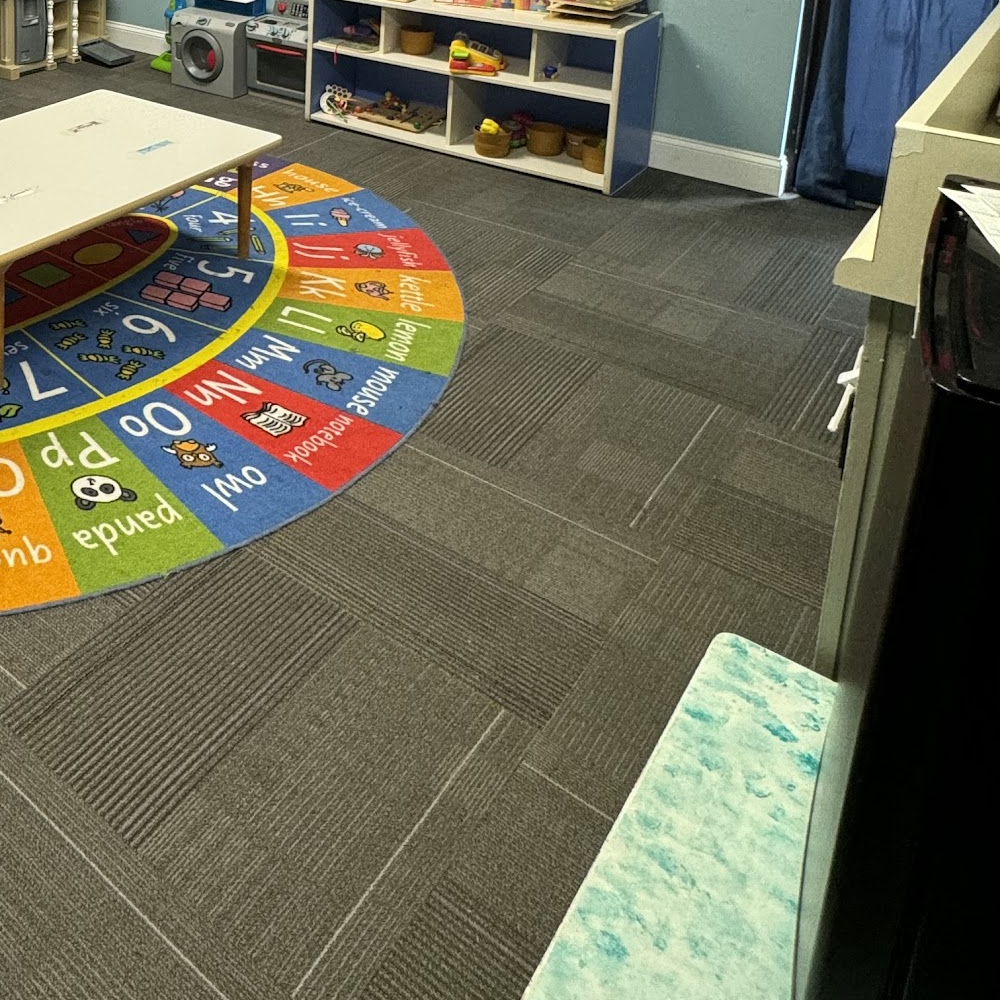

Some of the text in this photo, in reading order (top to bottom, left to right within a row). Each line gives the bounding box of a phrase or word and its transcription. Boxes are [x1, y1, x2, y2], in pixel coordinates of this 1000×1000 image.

[281, 168, 340, 193] house
[208, 210, 256, 226] 4
[163, 252, 195, 272] five
[292, 242, 351, 261] Jj
[377, 232, 424, 269] jellyfish
[196, 259, 255, 284] 5
[299, 270, 347, 299] Kk
[93, 301, 120, 317] six
[399, 273, 435, 313] kettle
[122, 314, 176, 343] 6
[277, 305, 333, 335] Ll
[235, 334, 301, 370] Mm
[384, 317, 432, 362] lemon
[19, 360, 69, 402] 7
[183, 369, 263, 406] Nn
[346, 366, 400, 417] mouse
[119, 401, 192, 437] Oo
[40, 431, 120, 470] Pp
[283, 413, 355, 467] notebook
[200, 465, 268, 513] owl
[71, 492, 184, 557] panda
